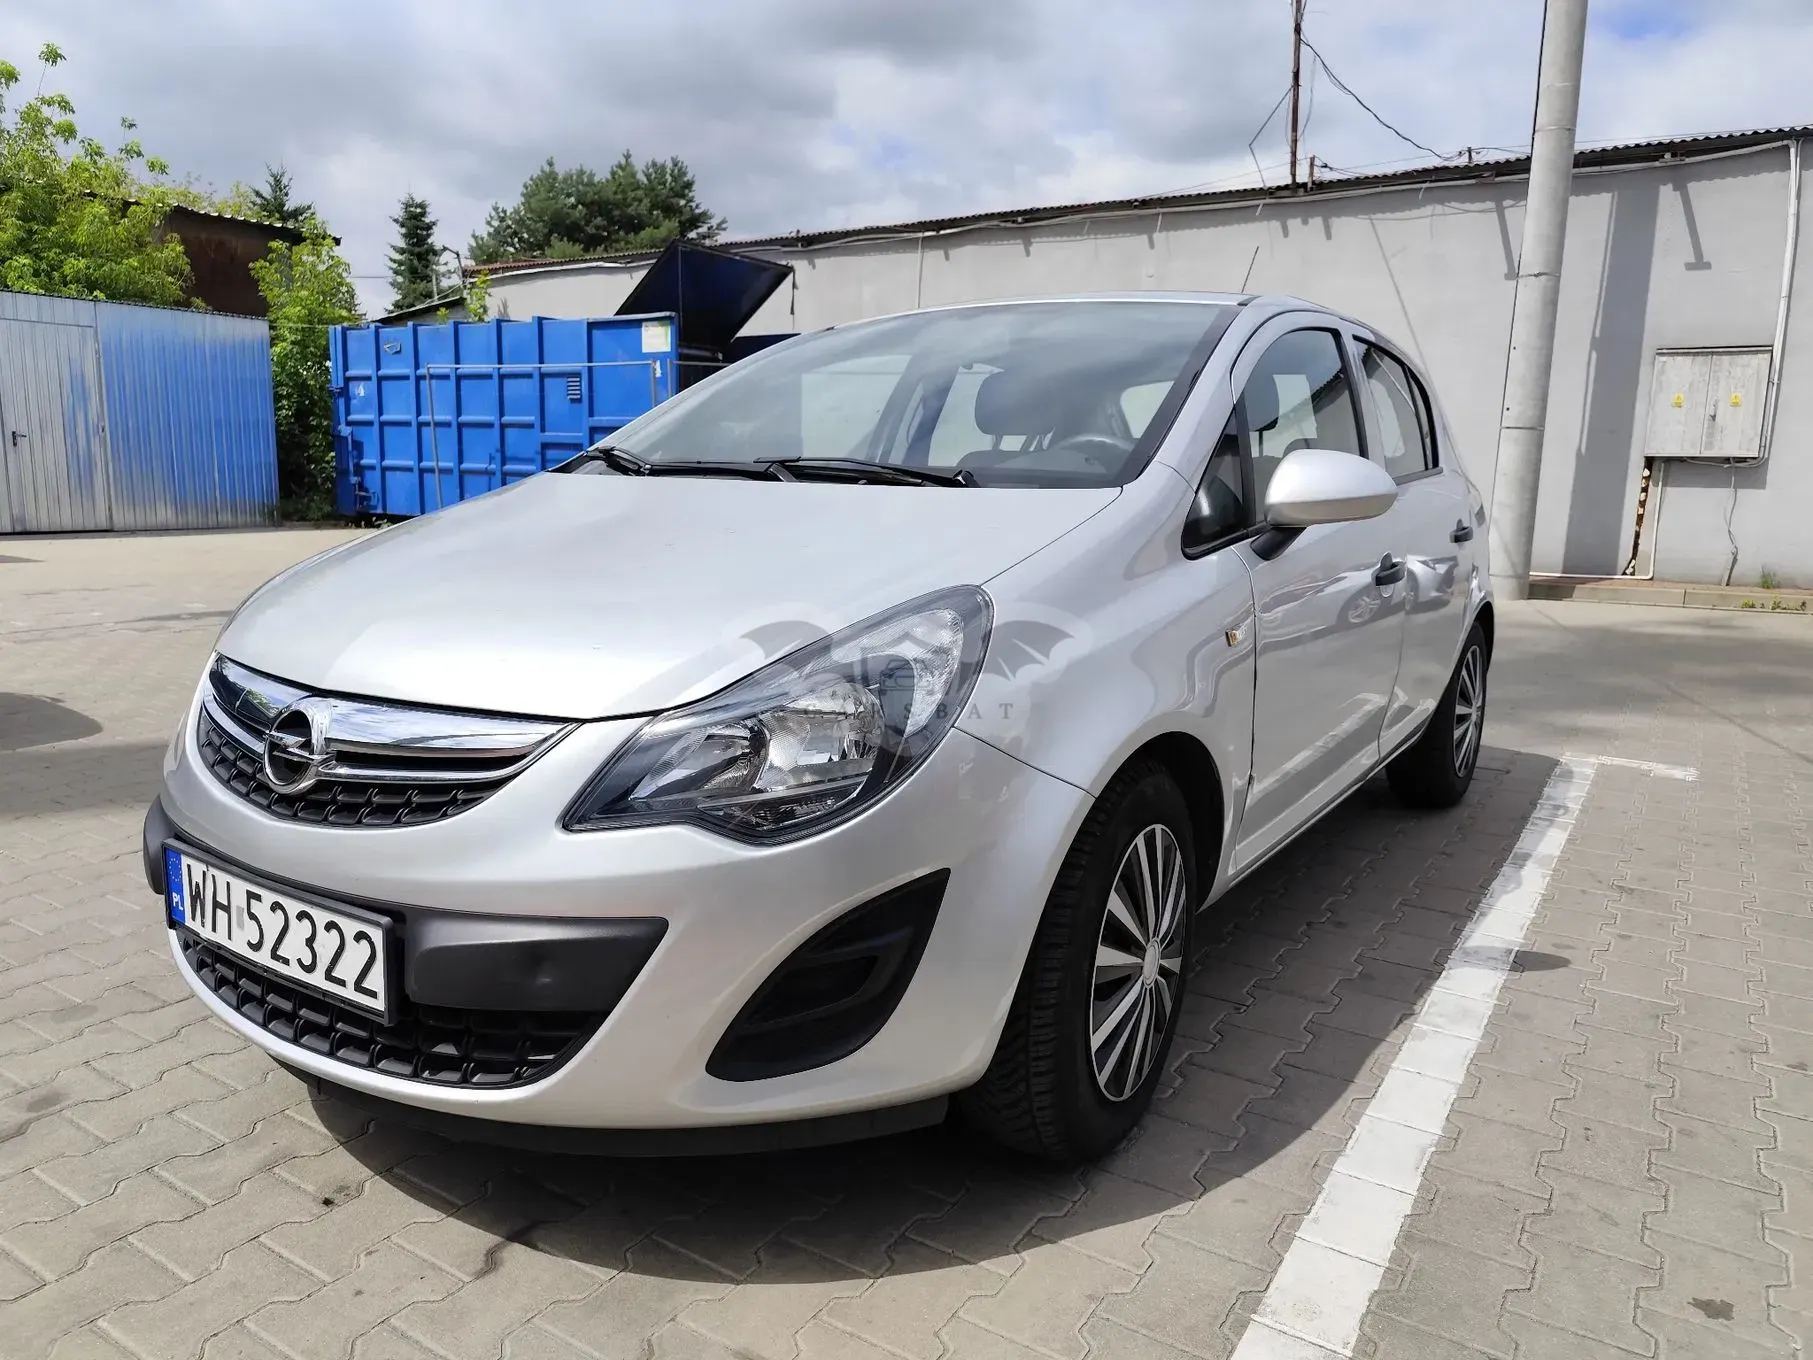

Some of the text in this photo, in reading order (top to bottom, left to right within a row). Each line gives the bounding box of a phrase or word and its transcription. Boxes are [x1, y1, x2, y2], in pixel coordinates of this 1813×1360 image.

[172, 892, 184, 910] PL
[187, 863, 378, 999] WH 52322
